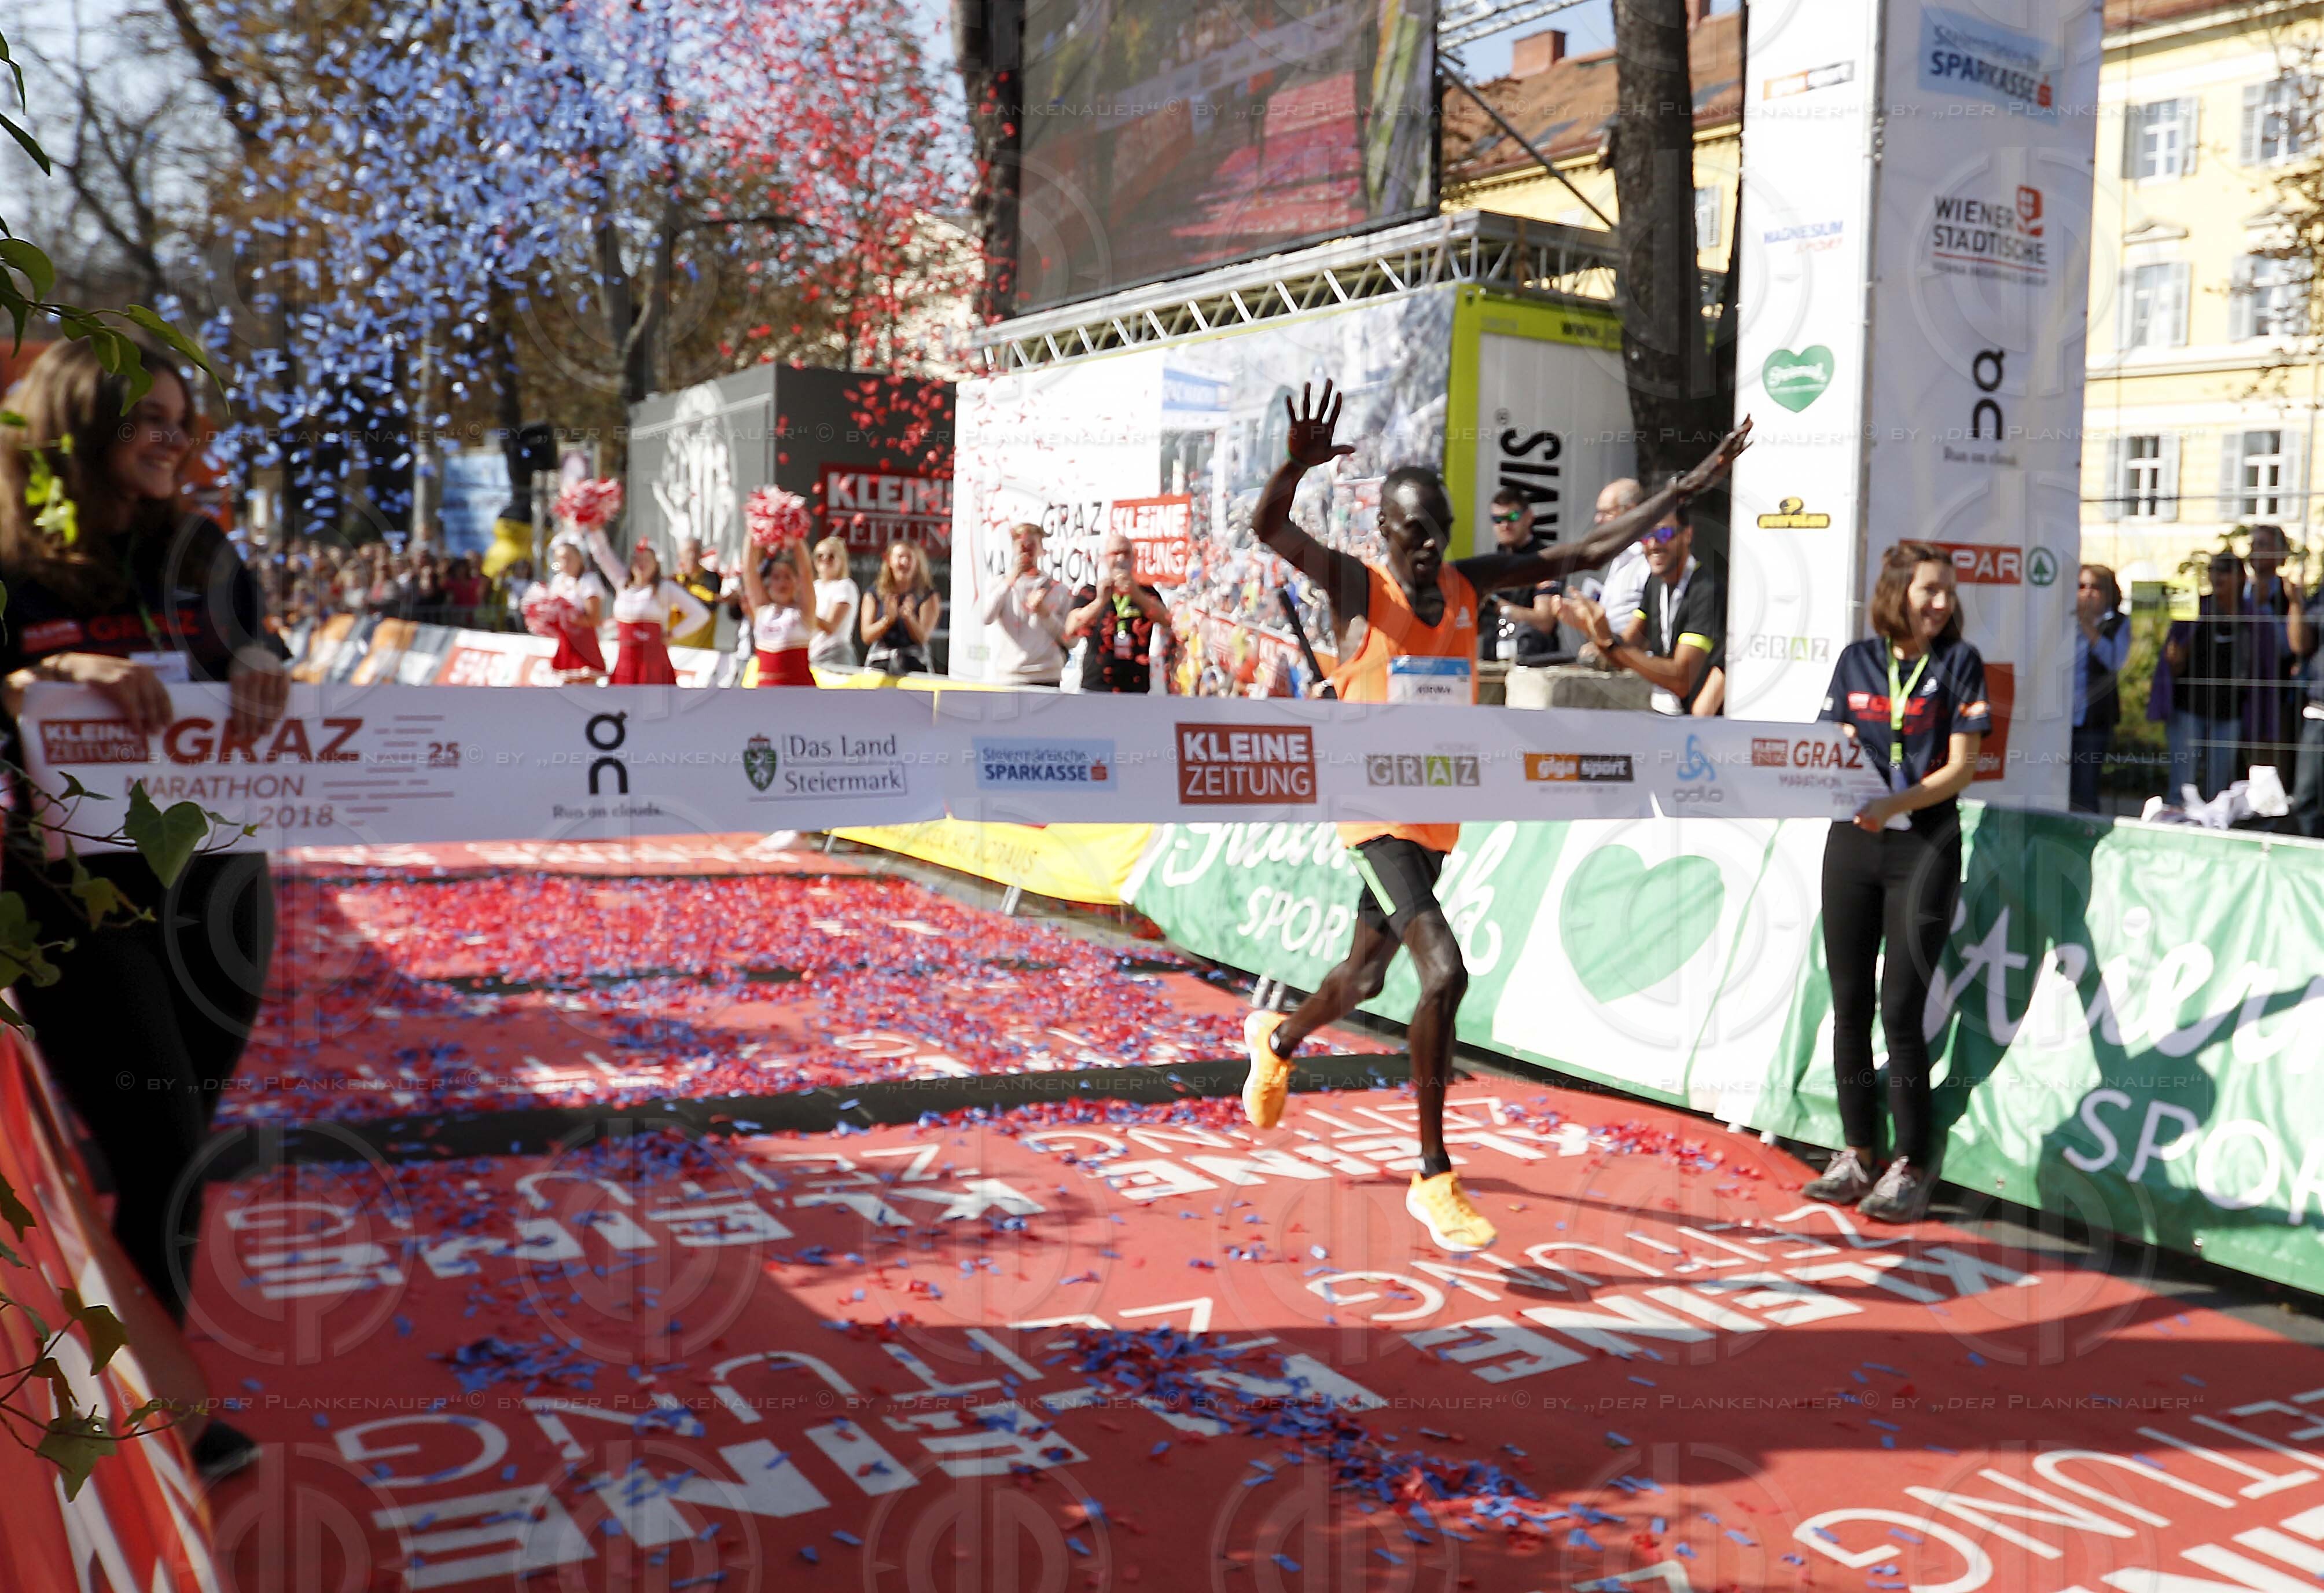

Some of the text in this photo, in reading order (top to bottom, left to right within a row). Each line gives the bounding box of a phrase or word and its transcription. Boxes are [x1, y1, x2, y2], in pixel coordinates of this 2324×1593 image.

[1930, 50, 2036, 102] SPARKASSE
[1934, 197, 2014, 229] WIENER
[828, 472, 953, 515] KLEIN
[1113, 502, 1188, 538] KLEINE
[1952, 549, 2020, 579] PAR
[163, 716, 363, 767] GRAZ
[789, 733, 896, 758] Das Land
[1183, 732, 1308, 762] KLEINE
[1793, 739, 1863, 769] GRAZ
[784, 768, 903, 794] Steiermark
[983, 764, 1088, 783] SPARKASSE
[1185, 766, 1311, 797] ZEITUNG
[1366, 755, 1480, 786] GRAZ
[1538, 760, 1627, 780] giga sport
[124, 774, 305, 799] MARATHON
[258, 803, 334, 829] 2018
[1237, 885, 1359, 961] SPOR
